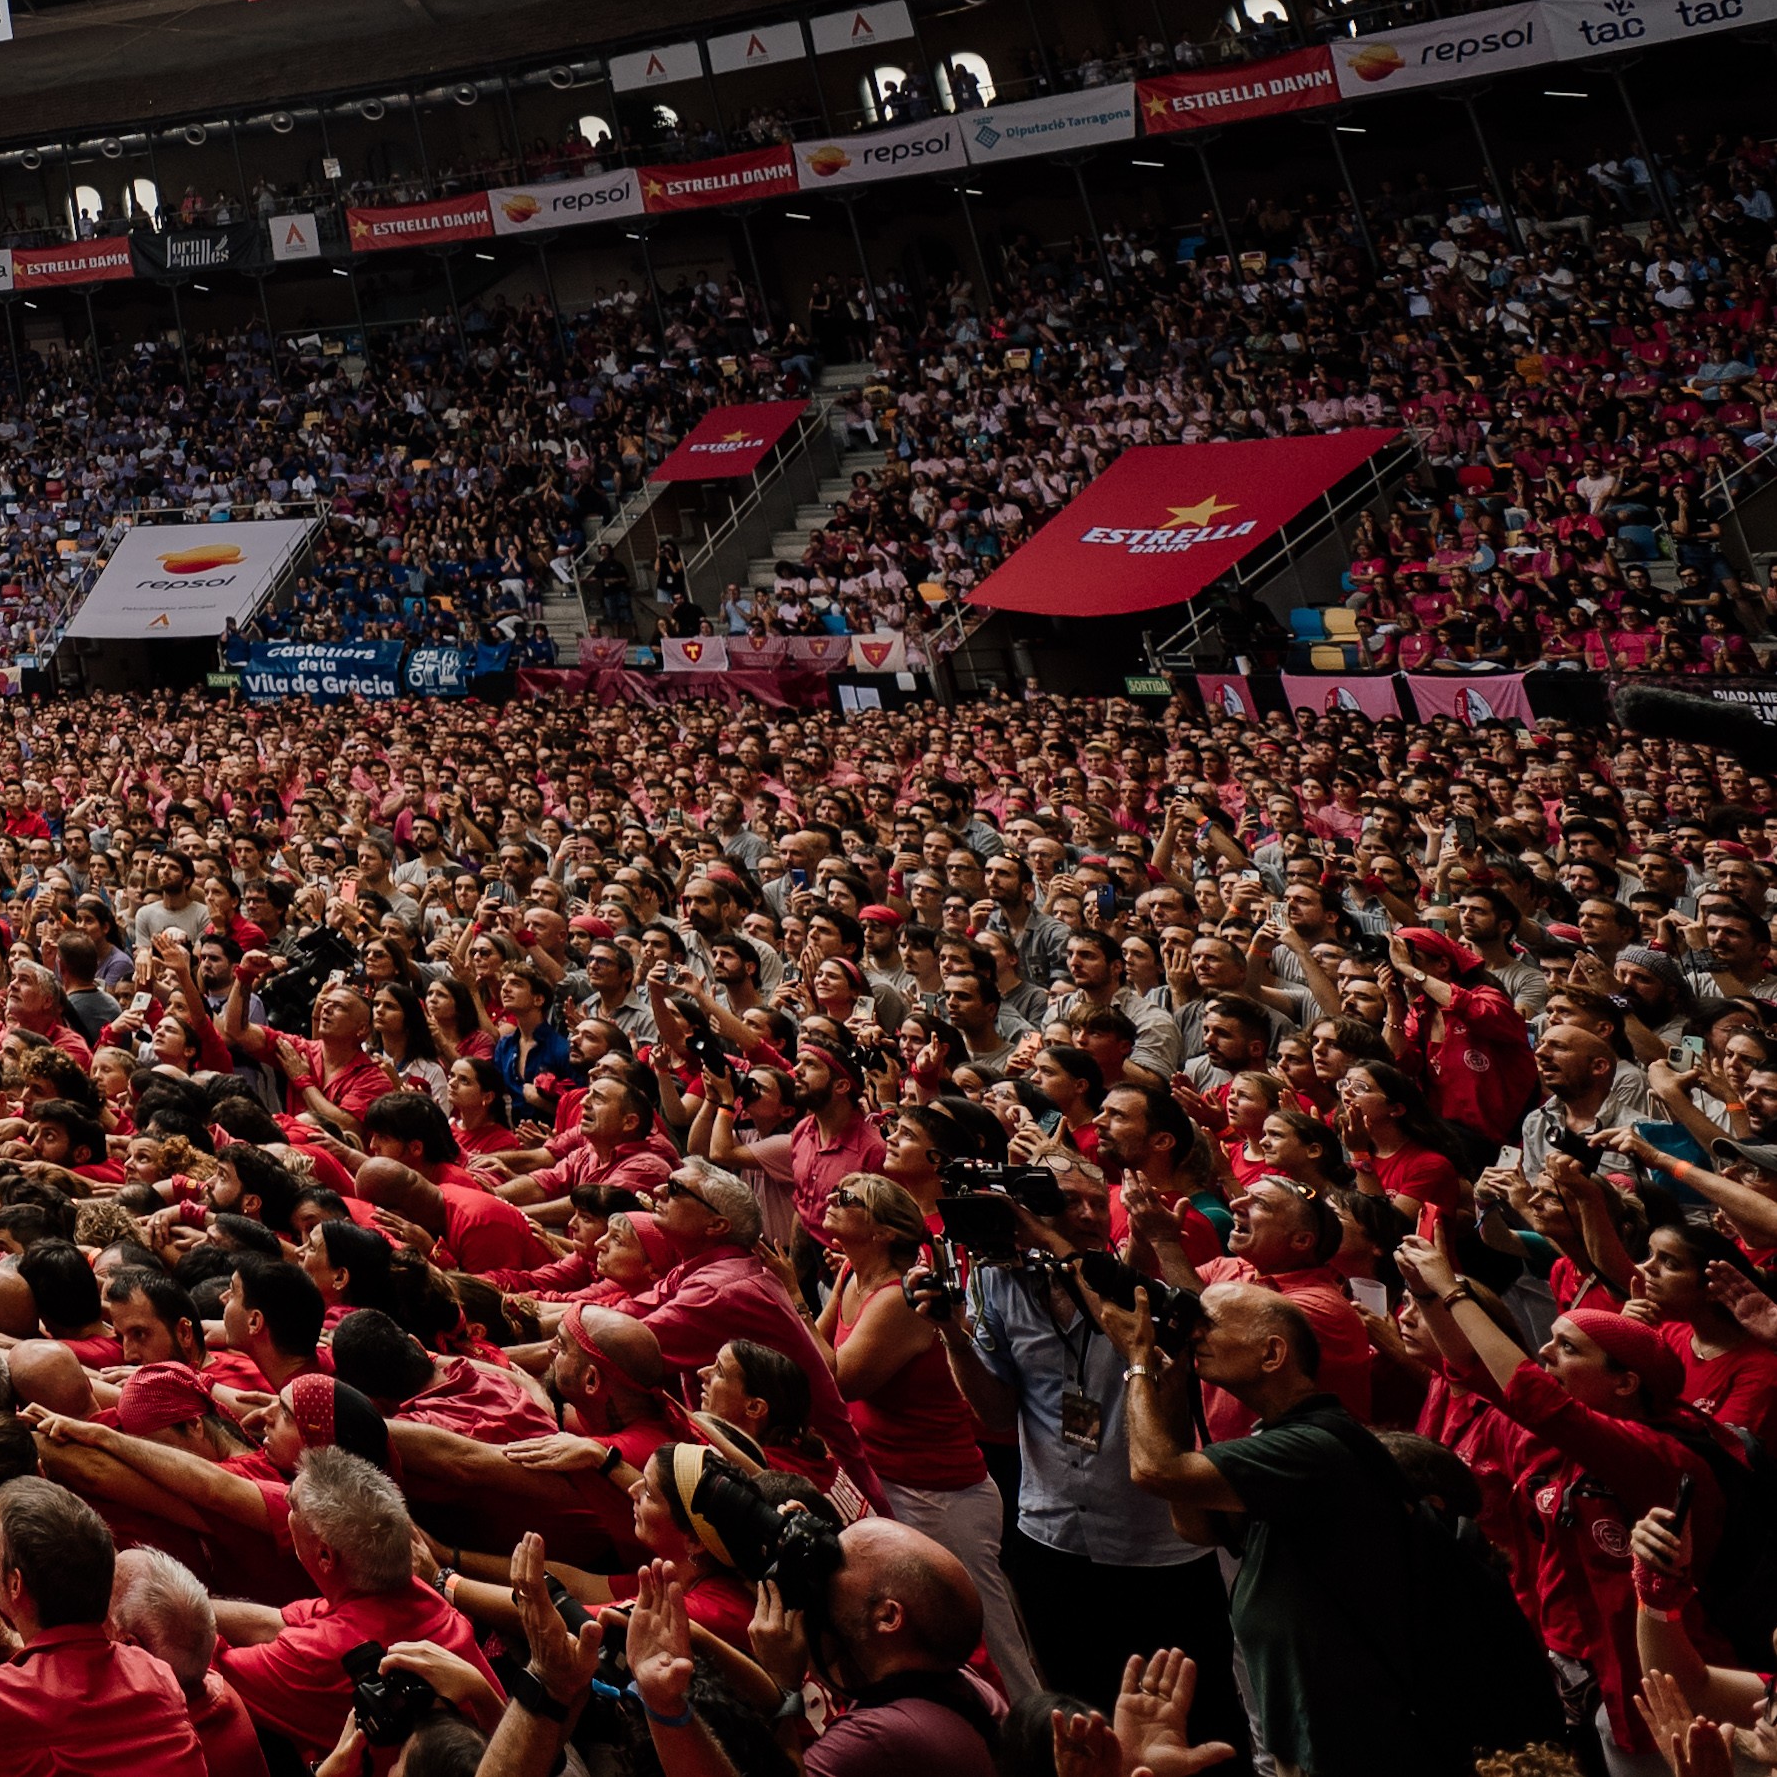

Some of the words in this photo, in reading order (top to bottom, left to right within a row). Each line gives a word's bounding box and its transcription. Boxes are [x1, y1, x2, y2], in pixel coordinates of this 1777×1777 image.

[1421, 21, 1533, 66] repsol
[1579, 16, 1646, 47] tac
[1171, 82, 1266, 114] ESTRELLA
[1270, 68, 1333, 97] DAMM
[1005, 116, 1066, 140] Diputació
[1067, 107, 1131, 131] Tarragona
[863, 134, 951, 166] repsol
[666, 171, 740, 196] ESTRELLA
[741, 162, 793, 186] DAMM
[552, 182, 630, 213] repsol
[373, 216, 442, 236] ESTRELLA
[443, 209, 490, 229] DAMM
[26, 259, 87, 276] ESTRELLA
[89, 252, 130, 269] DAMM
[689, 439, 764, 452] ESTRELLA
[1080, 520, 1258, 545] ESTRELLA
[1127, 542, 1194, 554] DAMM
[136, 575, 236, 591] repsol
[297, 658, 318, 672] de
[319, 657, 337, 672] la
[407, 650, 429, 687] CVG
[246, 672, 289, 693] Vila
[291, 673, 320, 694] de
[321, 673, 395, 696] Gràcia
[1128, 678, 1171, 695] SORTIDA
